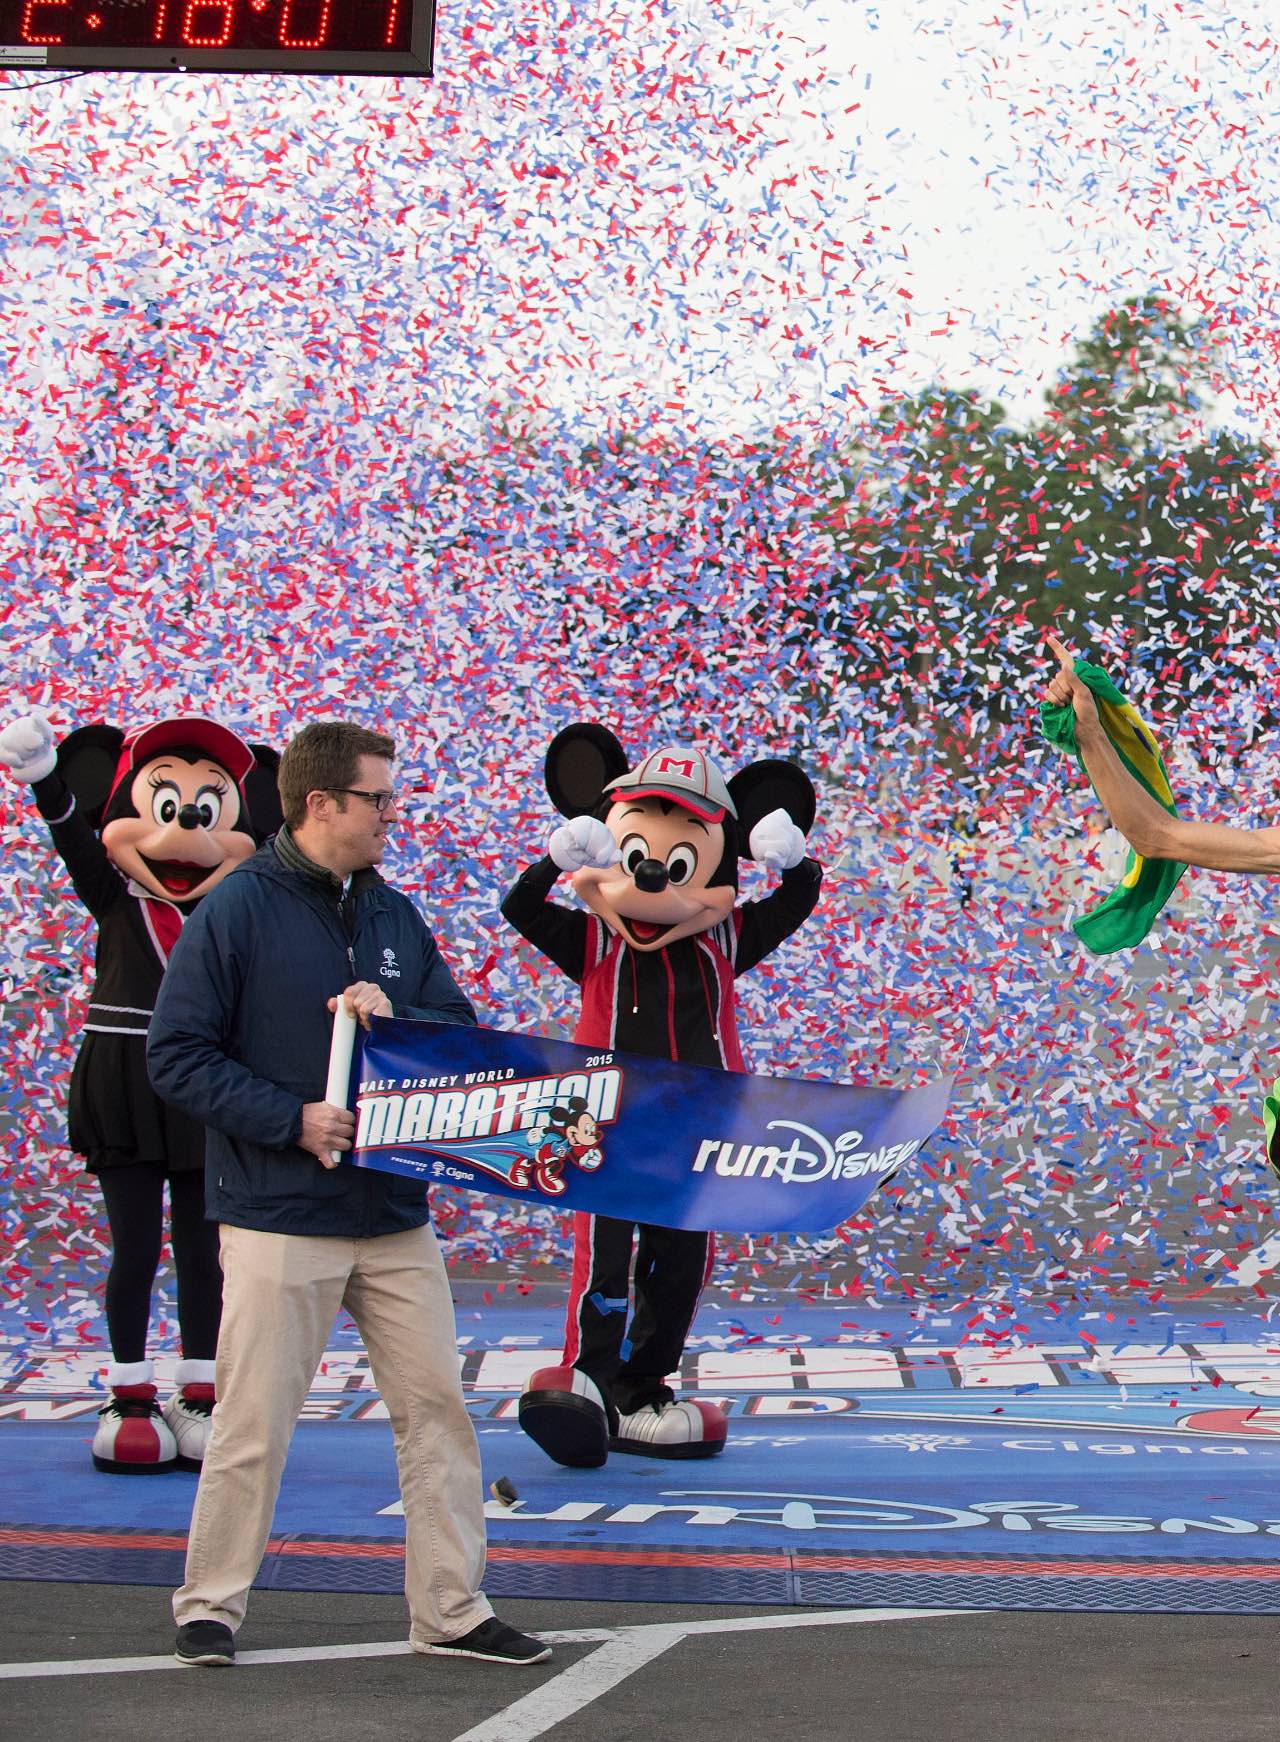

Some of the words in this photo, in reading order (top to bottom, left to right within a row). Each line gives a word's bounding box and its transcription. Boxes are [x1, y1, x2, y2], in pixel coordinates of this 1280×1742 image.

[657, 757, 696, 779] M
[379, 966, 401, 978] Cigna
[585, 1053, 613, 1069] 2015
[358, 1078, 396, 1094] WALT
[401, 1074, 459, 1090] DISNEY
[464, 1067, 515, 1085] WORLD
[355, 1069, 622, 1150] MARATHON
[445, 1166, 475, 1181] Cigna
[1000, 1439, 1250, 1456] Cigna
